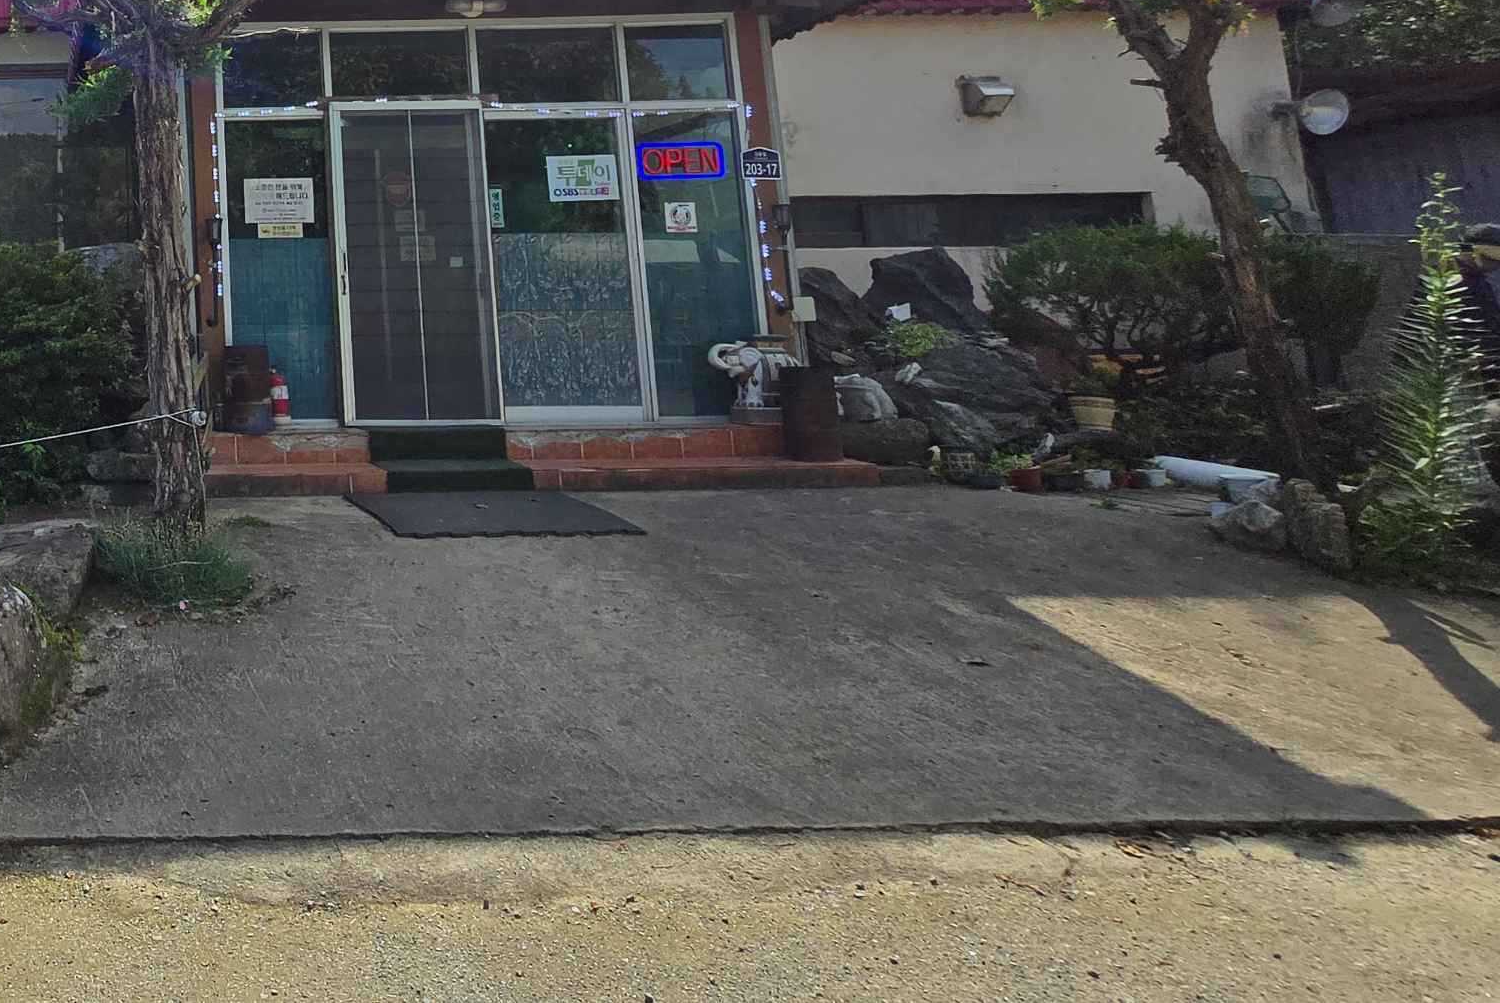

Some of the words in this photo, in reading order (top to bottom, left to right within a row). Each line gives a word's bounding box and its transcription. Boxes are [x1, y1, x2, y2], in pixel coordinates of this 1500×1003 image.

[642, 148, 720, 174] OPEN
[745, 163, 777, 175] 203-17
[555, 164, 611, 187] 투데이
[562, 188, 579, 196] SBS
